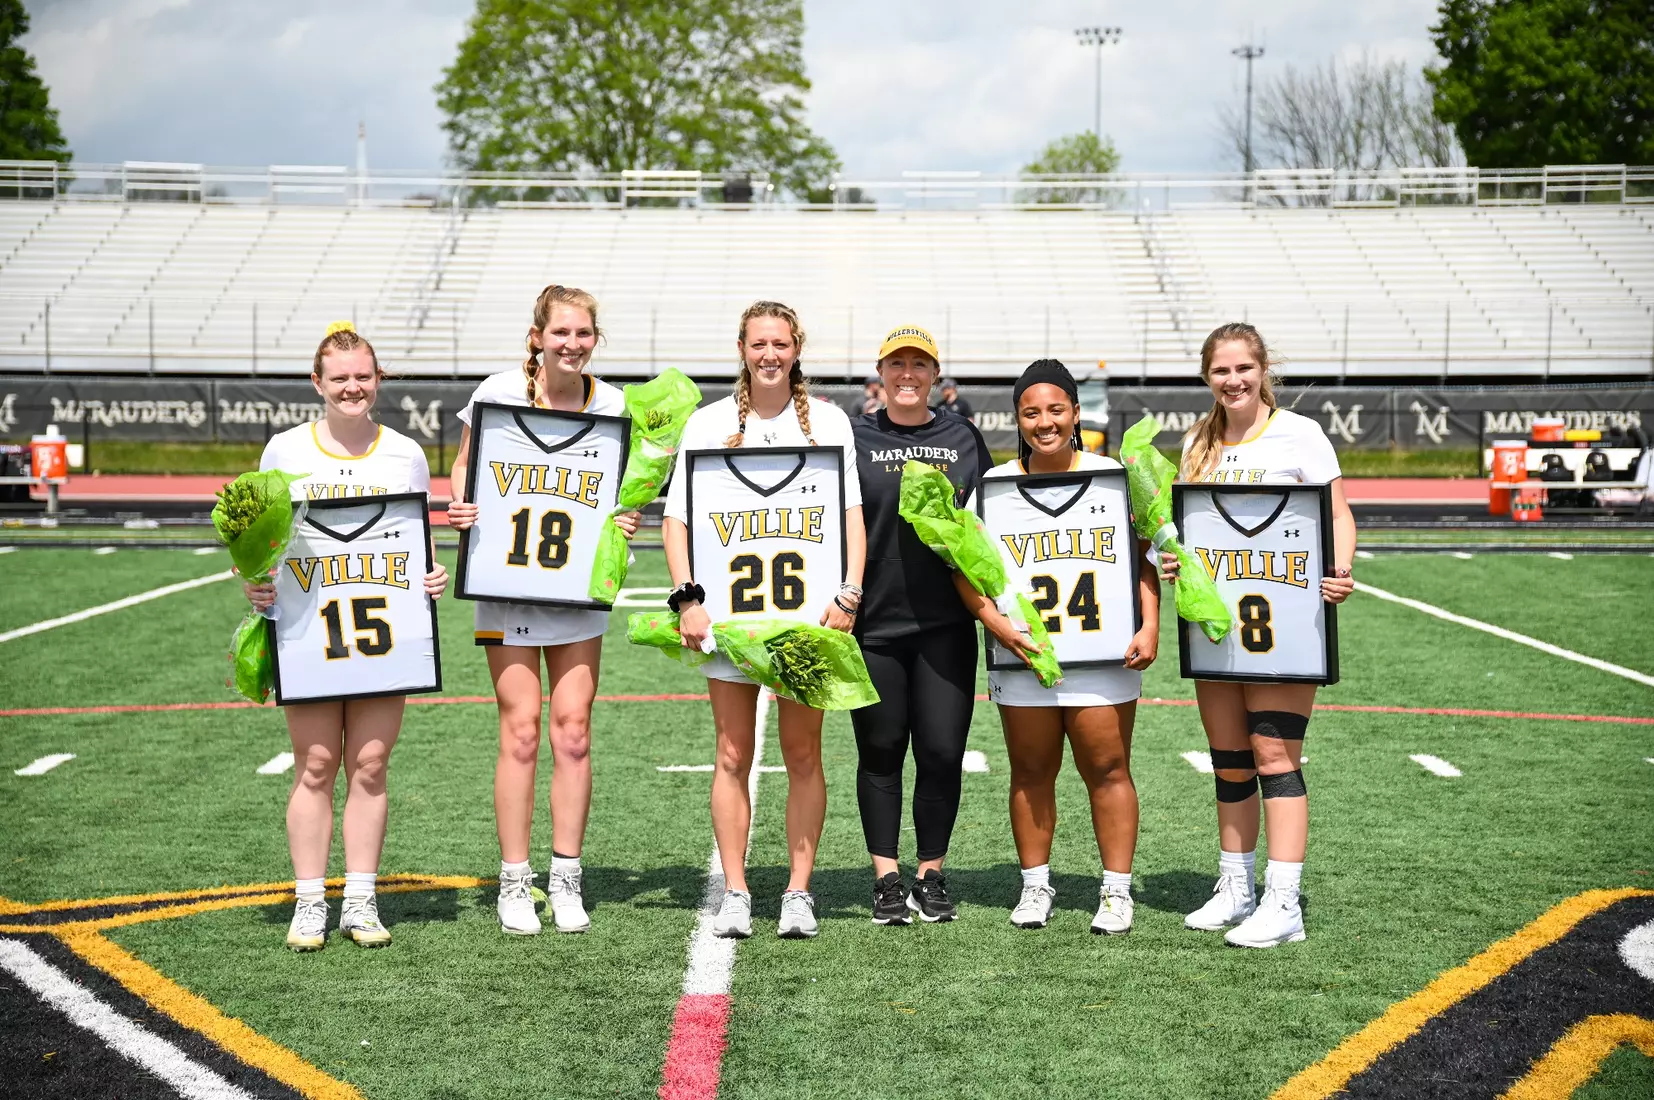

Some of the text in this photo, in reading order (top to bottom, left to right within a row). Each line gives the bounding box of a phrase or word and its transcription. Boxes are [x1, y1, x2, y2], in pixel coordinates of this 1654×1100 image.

[50, 396, 207, 429] MARAUDERS
[218, 398, 327, 427] MARAUD
[870, 446, 959, 463] MARAUDERS
[490, 460, 603, 509] VILLE
[506, 506, 574, 572] 18
[710, 505, 825, 547] VILLE
[1001, 525, 1117, 568] VILLE
[285, 550, 410, 593] VILLE
[728, 551, 807, 615] 26
[1194, 546, 1309, 590] VILLE
[1028, 569, 1102, 634] 24
[1236, 592, 1275, 655] 8
[319, 595, 395, 662] 15
